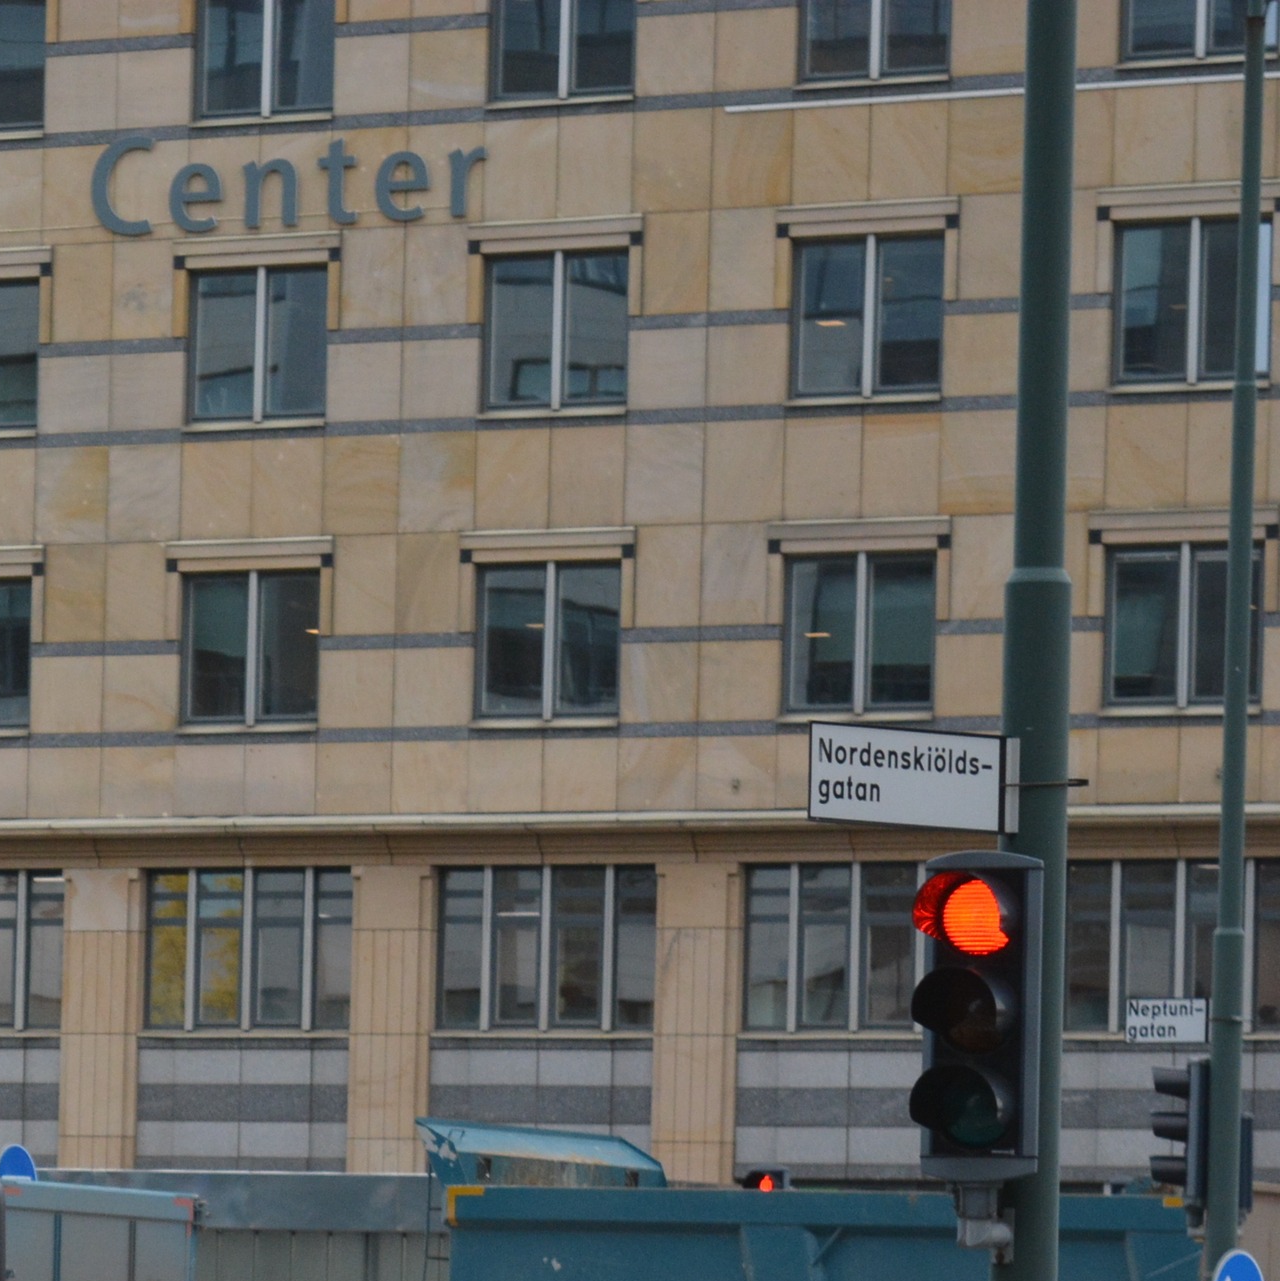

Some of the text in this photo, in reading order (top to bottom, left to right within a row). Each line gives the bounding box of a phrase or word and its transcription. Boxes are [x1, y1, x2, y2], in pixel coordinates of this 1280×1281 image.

[90, 135, 487, 237] Center
[818, 737, 993, 775] Nordenskiölds-
[818, 776, 881, 804] gatan
[1128, 1000, 1204, 1018] Neptuni-
[1128, 1023, 1177, 1040] gatan
